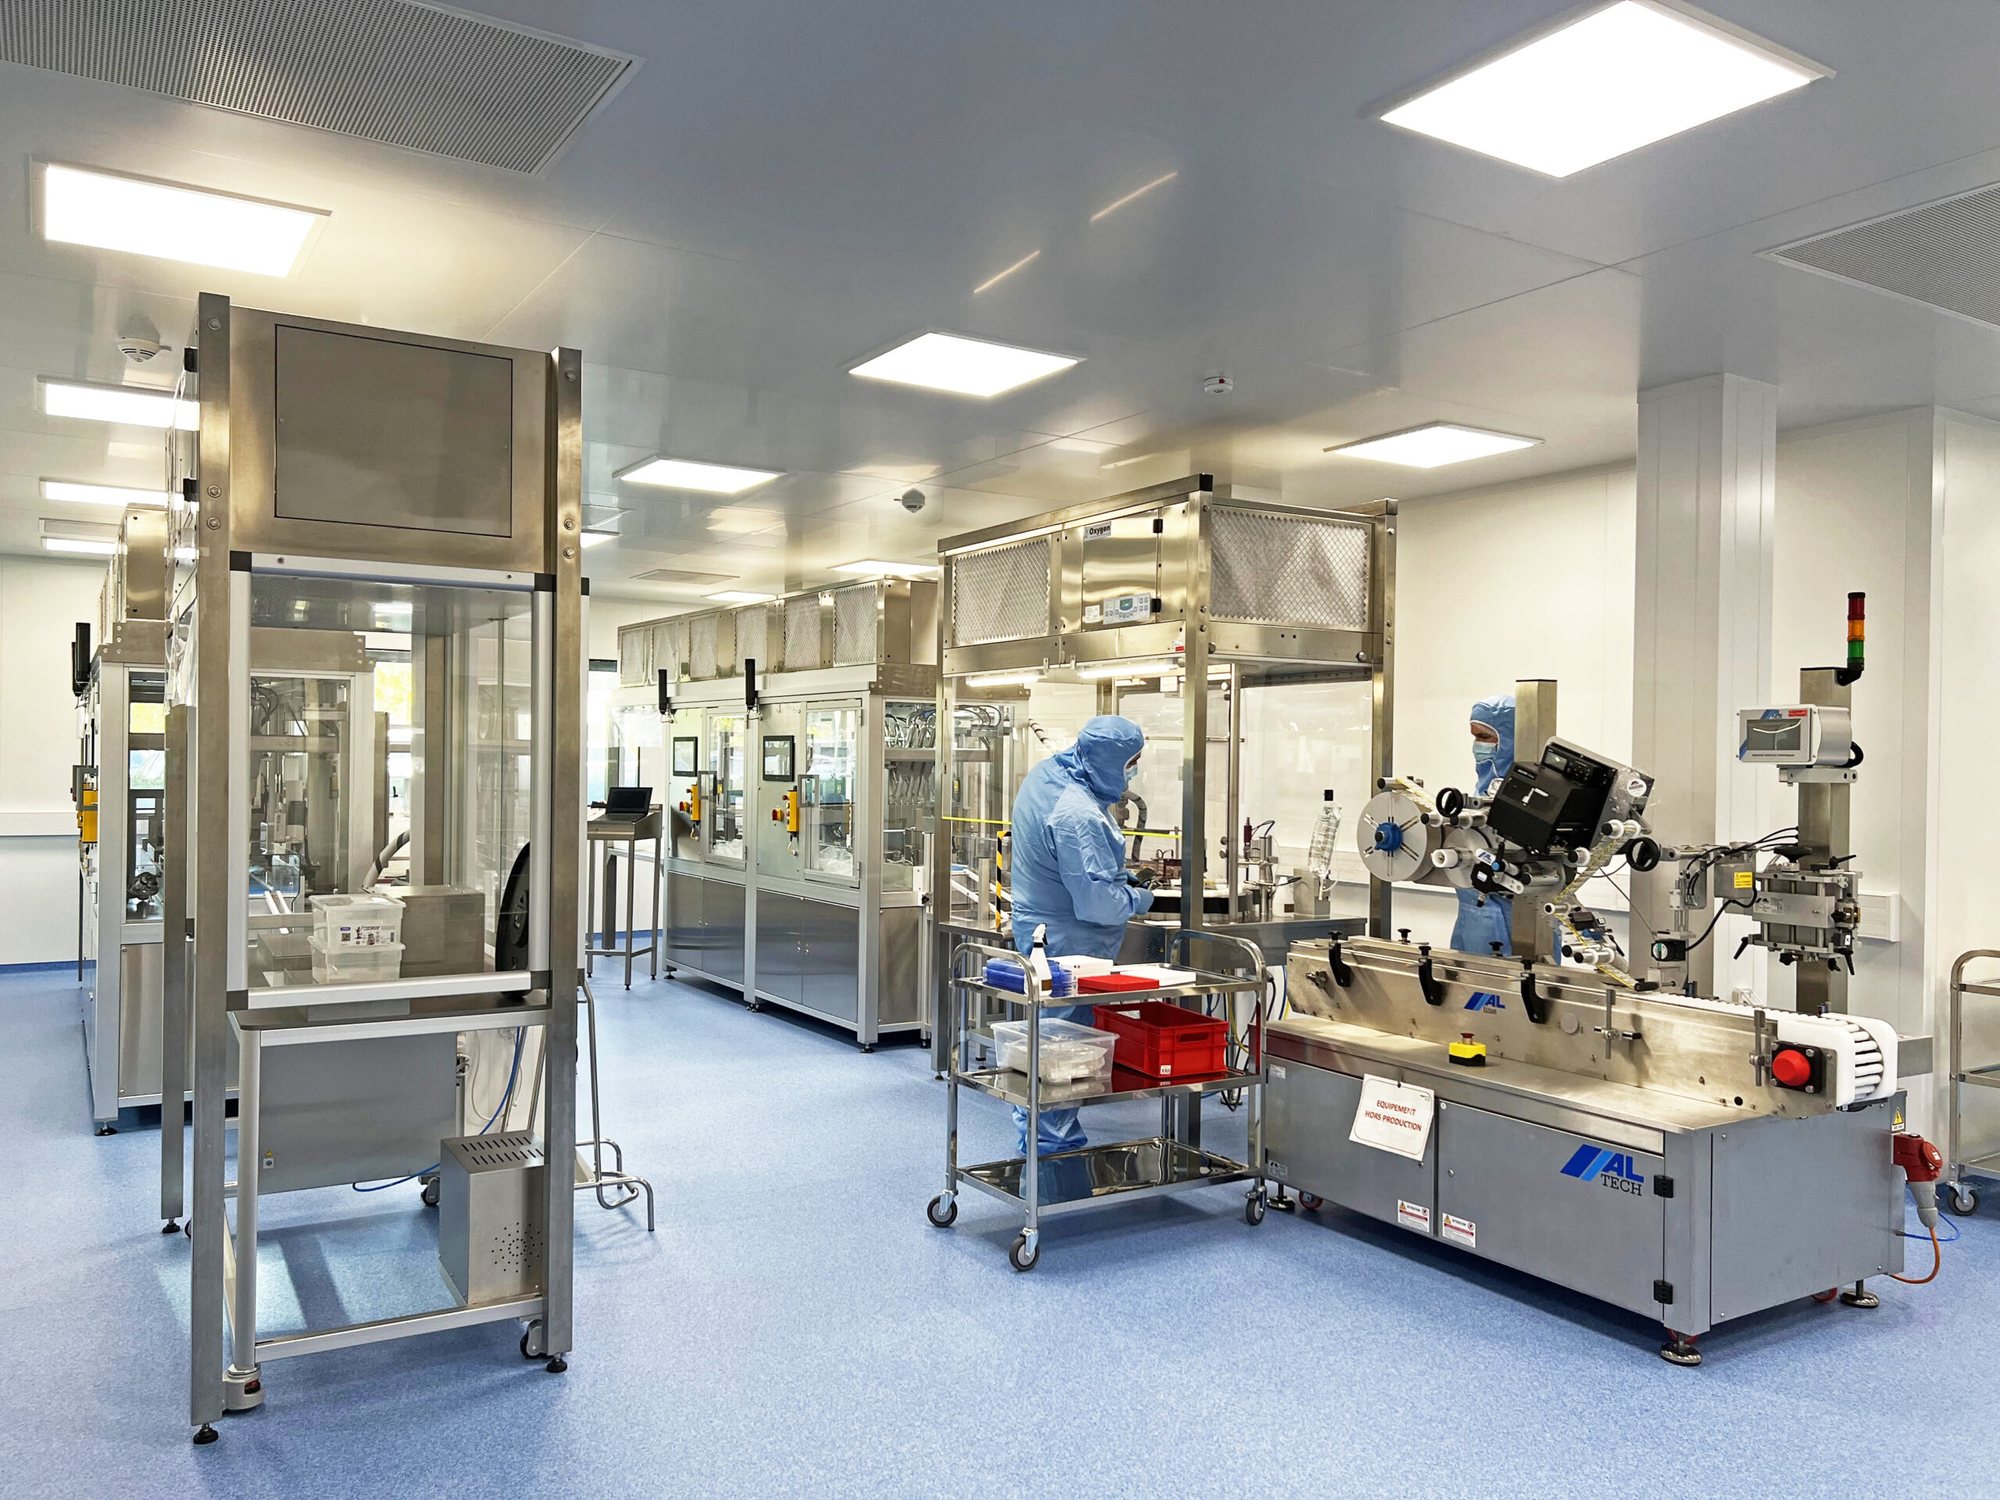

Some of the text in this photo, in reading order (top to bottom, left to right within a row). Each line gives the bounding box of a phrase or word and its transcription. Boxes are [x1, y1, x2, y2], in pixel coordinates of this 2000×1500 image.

[1089, 525, 1110, 535] Oxygen
[1485, 995, 1505, 1009] AL
[1376, 1099, 1416, 1116] EQUIPEMENT
[1364, 1110, 1422, 1131] HORS PRODUCTION
[1602, 1153, 1644, 1184] AL
[1600, 1173, 1642, 1197] TECH
